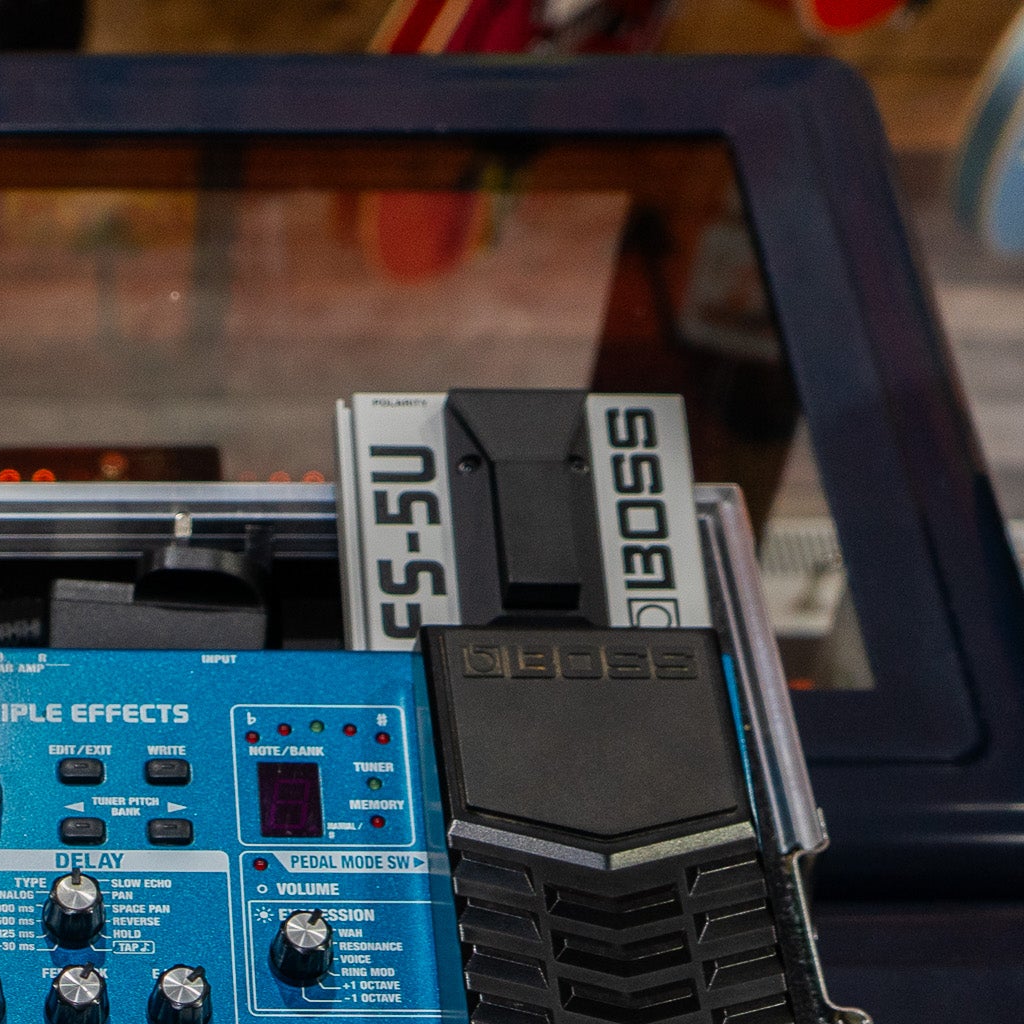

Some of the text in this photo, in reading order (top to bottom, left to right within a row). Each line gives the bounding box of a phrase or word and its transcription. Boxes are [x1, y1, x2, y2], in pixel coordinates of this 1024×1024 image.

[605, 408, 676, 589] BOSS
[201, 654, 237, 664] INPUT
[18, 664, 45, 673] AMP
[71, 704, 189, 723] EFFECTS
[48, 745, 112, 756] EDIT/EXIT
[147, 745, 186, 756] WRITE
[249, 746, 325, 757] NOTE/BANK
[353, 762, 394, 773] TUNER
[92, 796, 159, 806] TUNER PITCH
[349, 799, 404, 811] MEMORY
[111, 807, 141, 817] BANK
[55, 852, 125, 869] DELAY
[290, 855, 410, 870] PEDAL MODE SW
[14, 877, 47, 888] TYPE
[111, 879, 172, 888] SLOW ECHO
[277, 883, 340, 895] VOLUME
[112, 891, 133, 900] PAN
[18, 905, 34, 913] ms
[112, 904, 170, 914] SPACE PAN
[278, 908, 375, 922] EESSION
[18, 918, 34, 926] ms
[113, 917, 161, 926] REVERSE
[18, 931, 35, 939] ms
[113, 929, 141, 939] HOLD
[338, 928, 363, 938] WAH
[19, 943, 35, 951] ms
[119, 943, 139, 953] TAP
[339, 941, 403, 951] RESONANCE
[340, 955, 371, 964] VOICE
[341, 968, 395, 977] RING MOD
[342, 981, 400, 990] +1 OCTAVE
[361, 993, 402, 1003] OCTAVE
